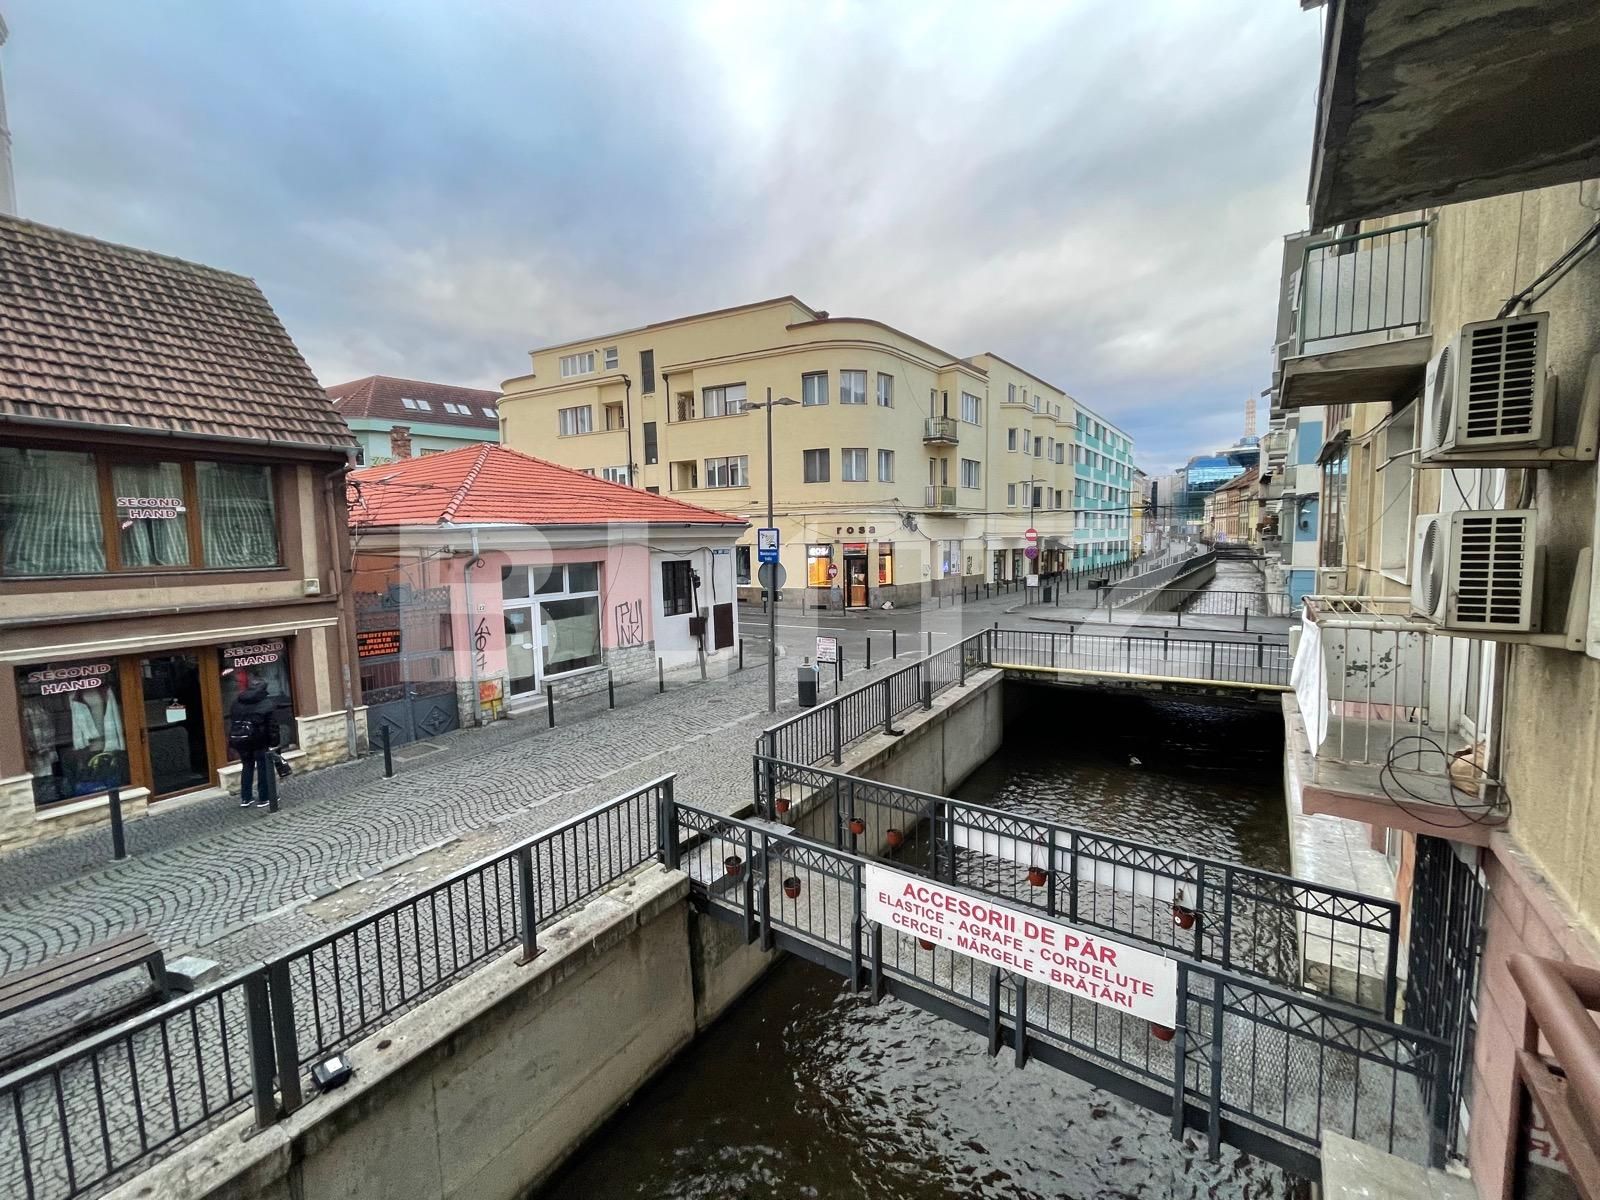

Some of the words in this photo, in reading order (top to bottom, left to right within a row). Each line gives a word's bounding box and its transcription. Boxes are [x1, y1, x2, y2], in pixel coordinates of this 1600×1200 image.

[117, 497, 182, 507] SECOND
[129, 508, 177, 519] HAND
[836, 526, 876, 535] rosa
[223, 641, 284, 658] SECOND
[234, 653, 279, 667] HAND
[28, 663, 112, 683] SECOND
[41, 677, 102, 695] HAND
[878, 891, 944, 924] ELASTICE
[958, 920, 1023, 952] AGRAFE
[902, 883, 1016, 933] ACCESORII
[1024, 921, 1055, 946] DE
[1065, 934, 1118, 968] PĂR
[891, 912, 943, 940] CERCEI
[957, 935, 1034, 973] MĂRGELE
